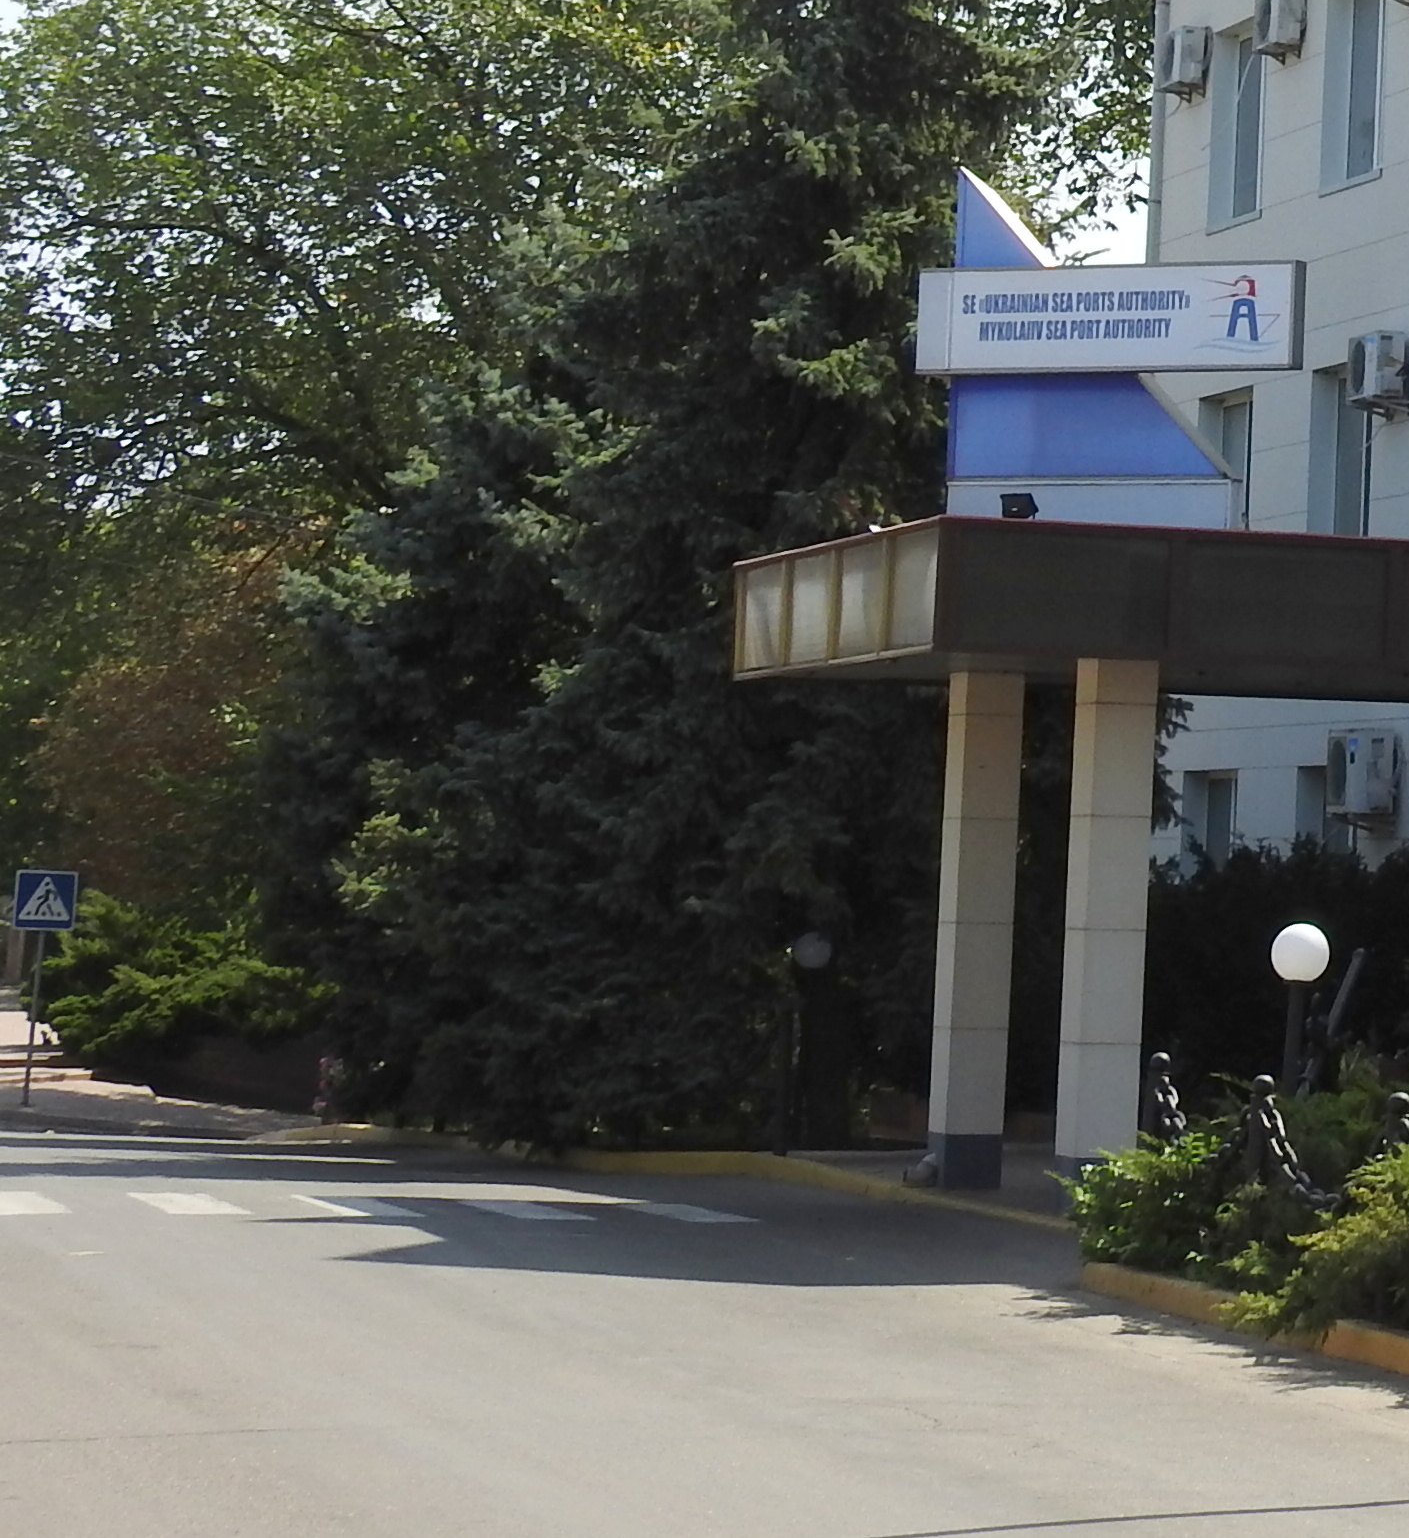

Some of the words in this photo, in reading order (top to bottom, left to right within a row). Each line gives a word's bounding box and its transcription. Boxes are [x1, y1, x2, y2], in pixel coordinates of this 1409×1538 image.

[962, 294, 976, 314] SE
[1052, 292, 1073, 313] SEA
[1076, 291, 1115, 312] PORTS
[1046, 320, 1068, 341] SEA
[1070, 319, 1102, 340] PORT
[1103, 318, 1172, 339] AUTHORITY
